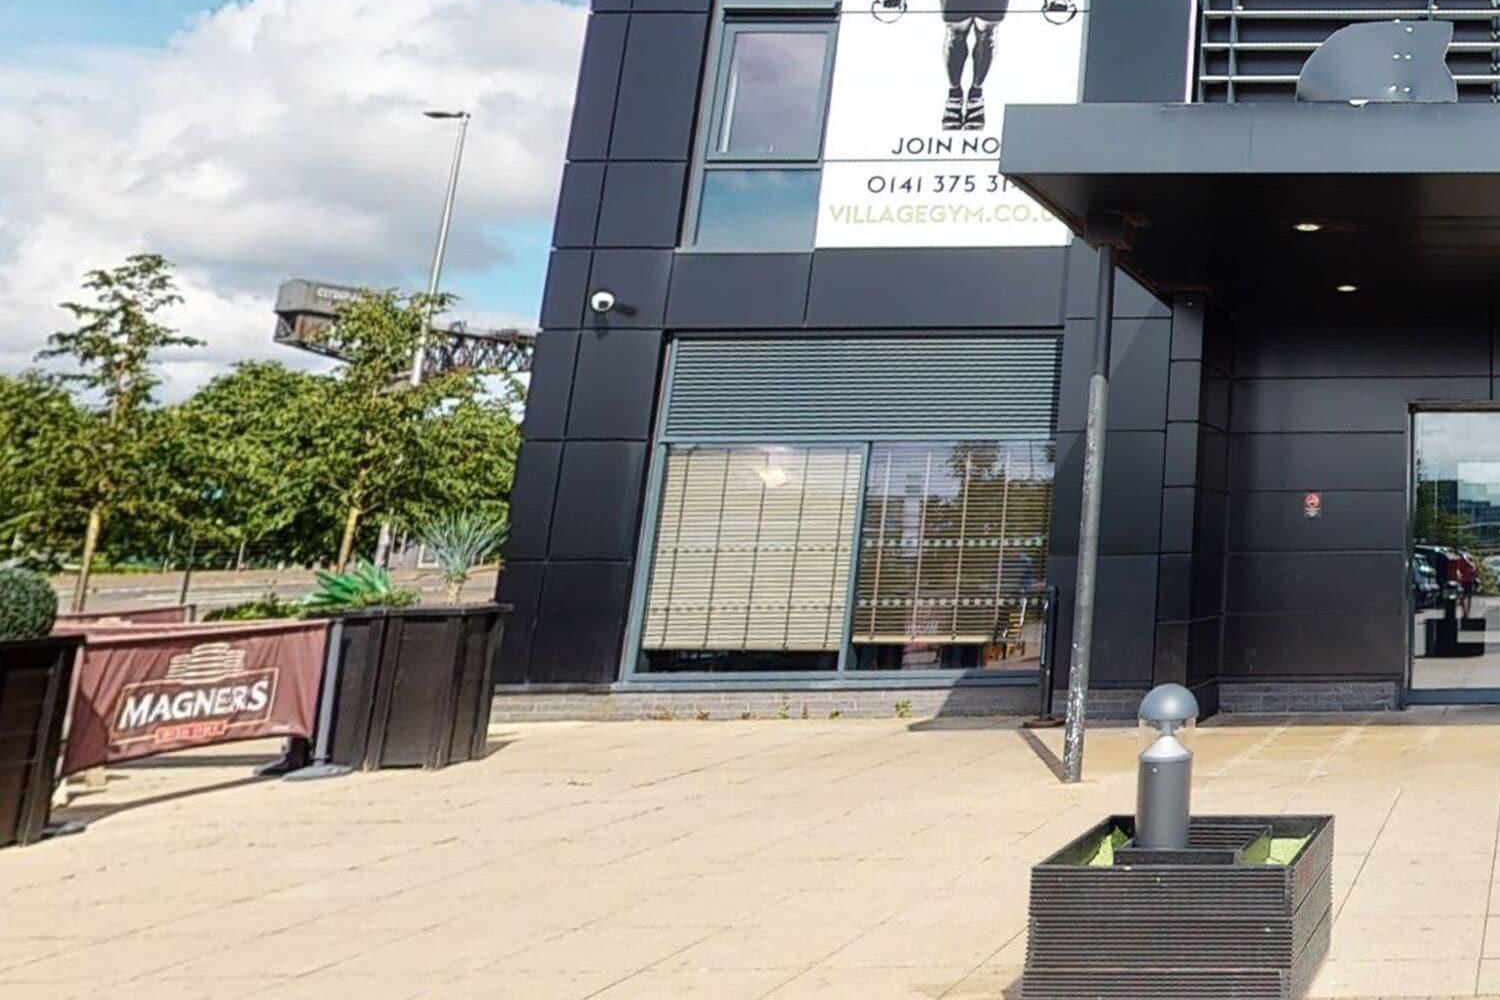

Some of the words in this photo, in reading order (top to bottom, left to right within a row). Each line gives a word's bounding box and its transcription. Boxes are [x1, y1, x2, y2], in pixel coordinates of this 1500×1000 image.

[891, 137, 953, 155] JOIN
[962, 137, 1000, 155] NO
[867, 175, 921, 193] 0141
[933, 175, 976, 193] 375
[118, 679, 270, 730] MAGNERS
